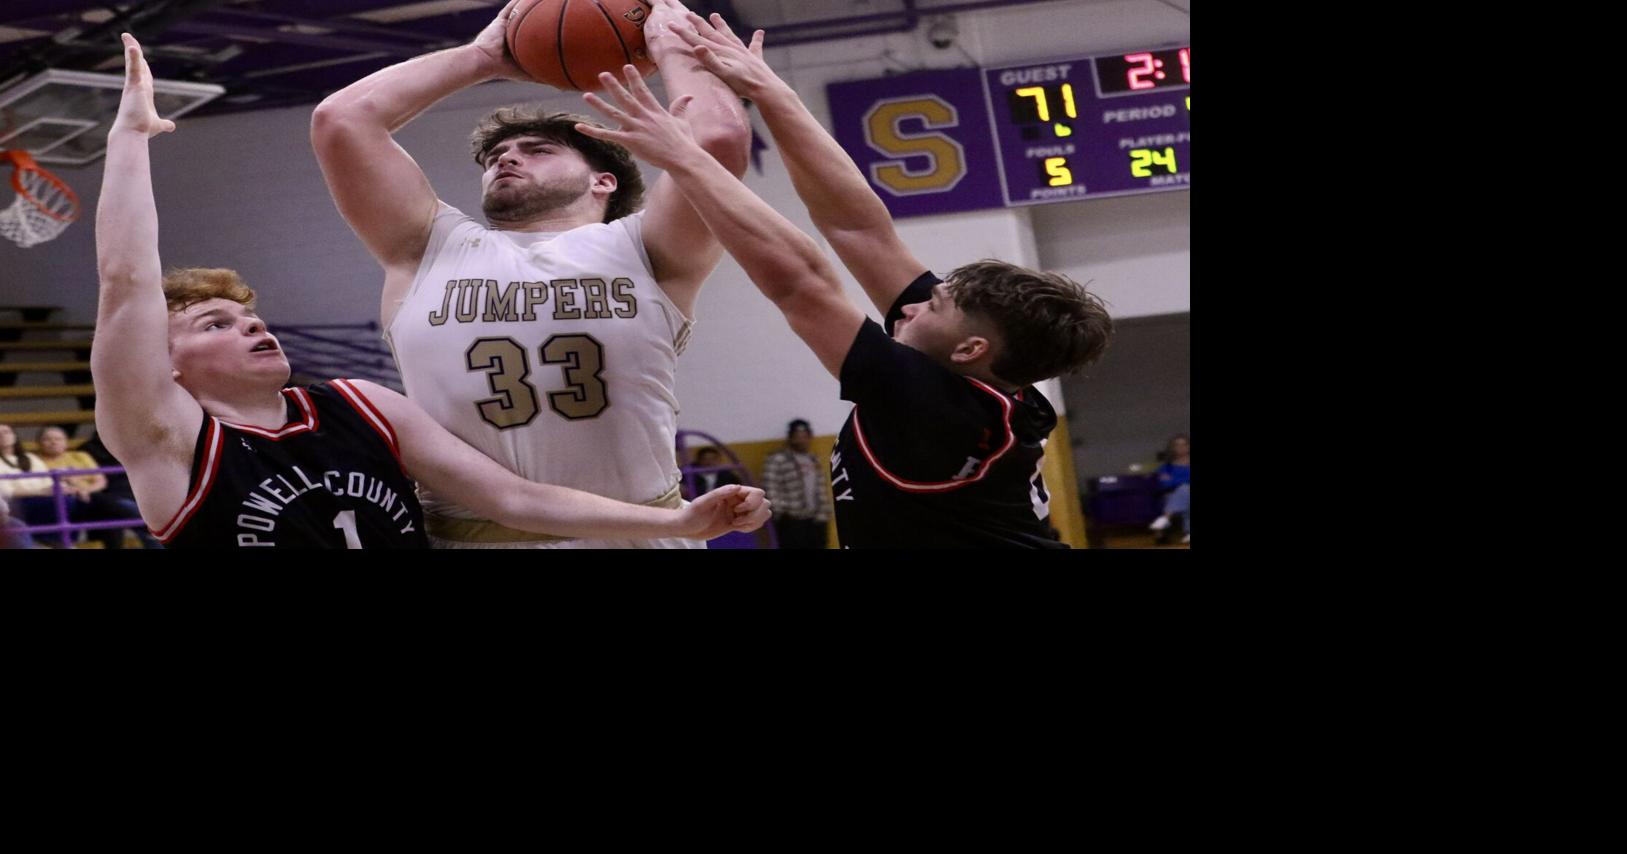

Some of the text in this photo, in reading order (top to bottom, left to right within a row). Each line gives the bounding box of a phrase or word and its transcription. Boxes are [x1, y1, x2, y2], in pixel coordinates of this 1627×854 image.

[1001, 65, 1071, 85] GUEST
[1016, 83, 1078, 122] 71
[1103, 104, 1177, 123] PERIOD
[862, 94, 967, 196] S
[1129, 147, 1177, 178] 24
[1045, 157, 1073, 187] 5
[428, 277, 638, 327] JUMPERS
[464, 332, 612, 432] 33
[236, 465, 415, 547] POWELL COUNTY
[332, 509, 364, 549] 1
